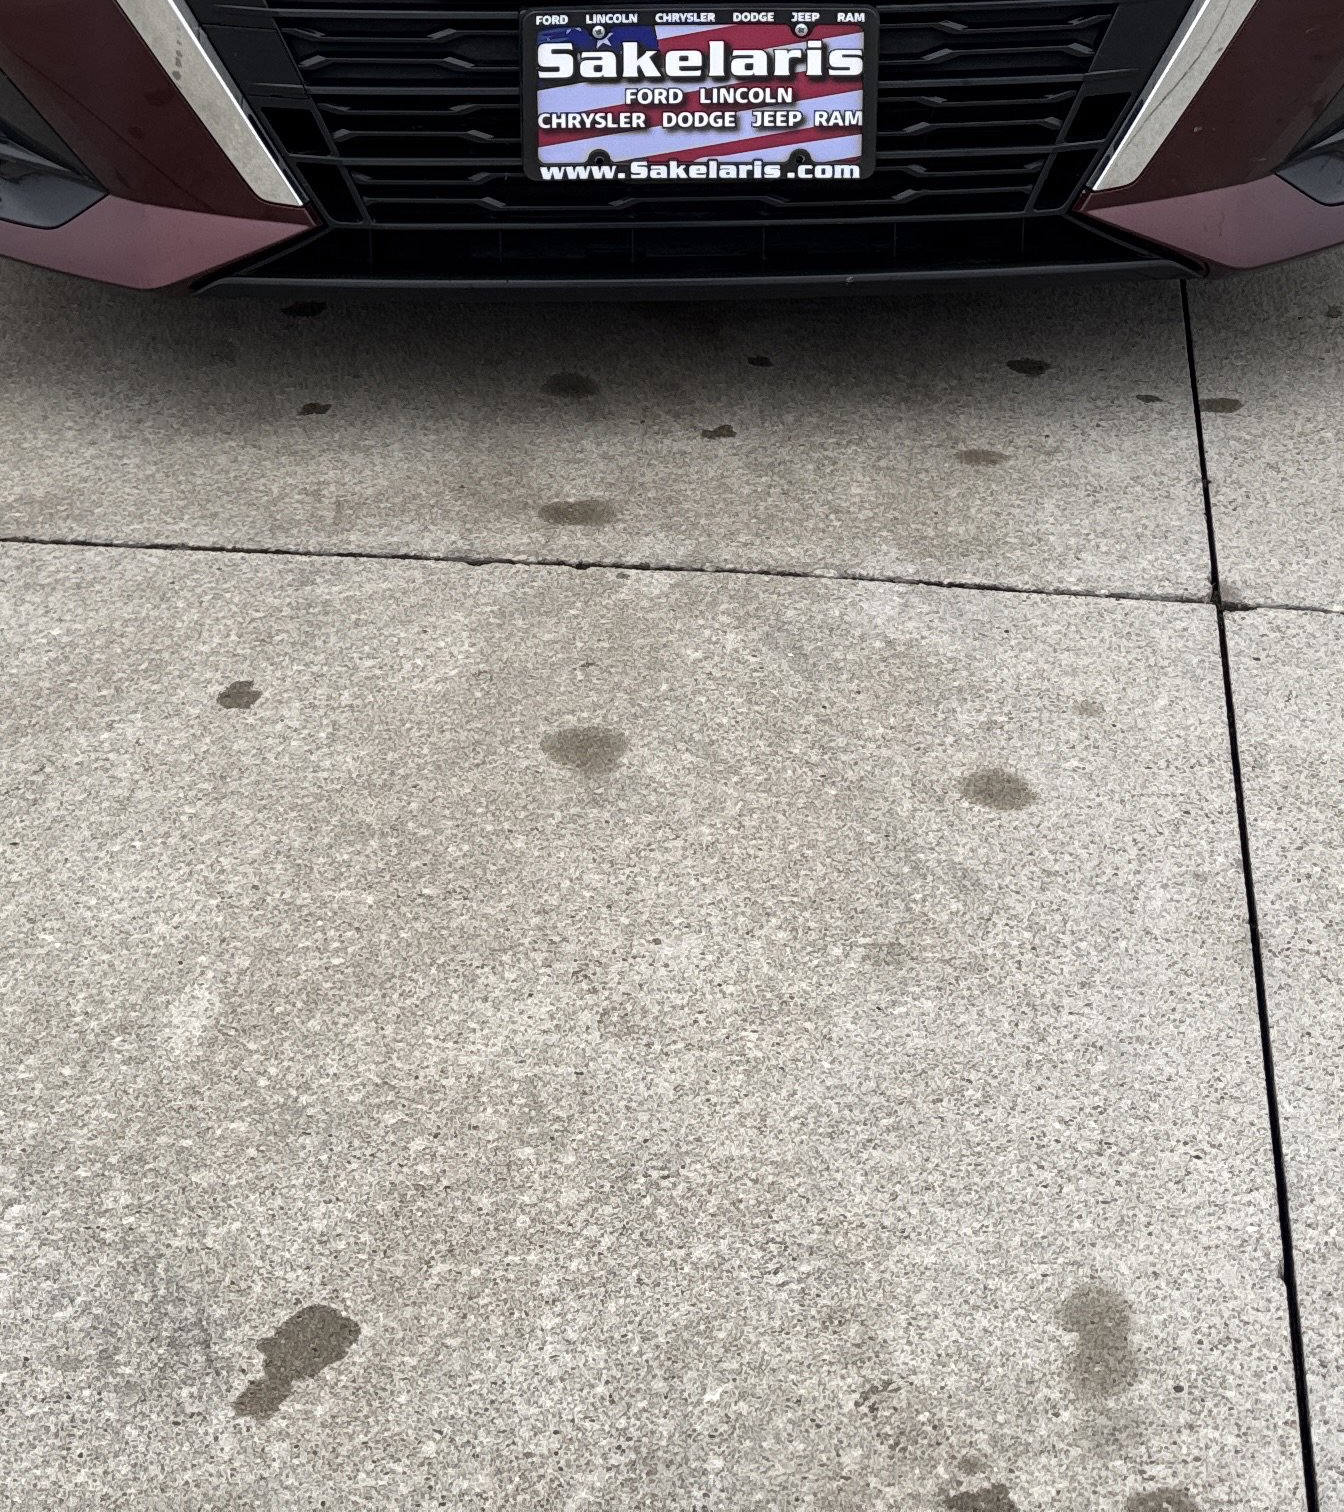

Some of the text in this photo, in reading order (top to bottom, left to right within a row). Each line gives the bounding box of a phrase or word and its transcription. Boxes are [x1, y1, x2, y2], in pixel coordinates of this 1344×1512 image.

[535, 11, 866, 26] FORD LINCOLN CHRYSLER DODGE JEEP RAM
[537, 39, 864, 79] Sakelaris
[624, 87, 793, 105] FORD LINCOLN
[537, 110, 863, 129] CHRYSLER DODGE JEEP RAM
